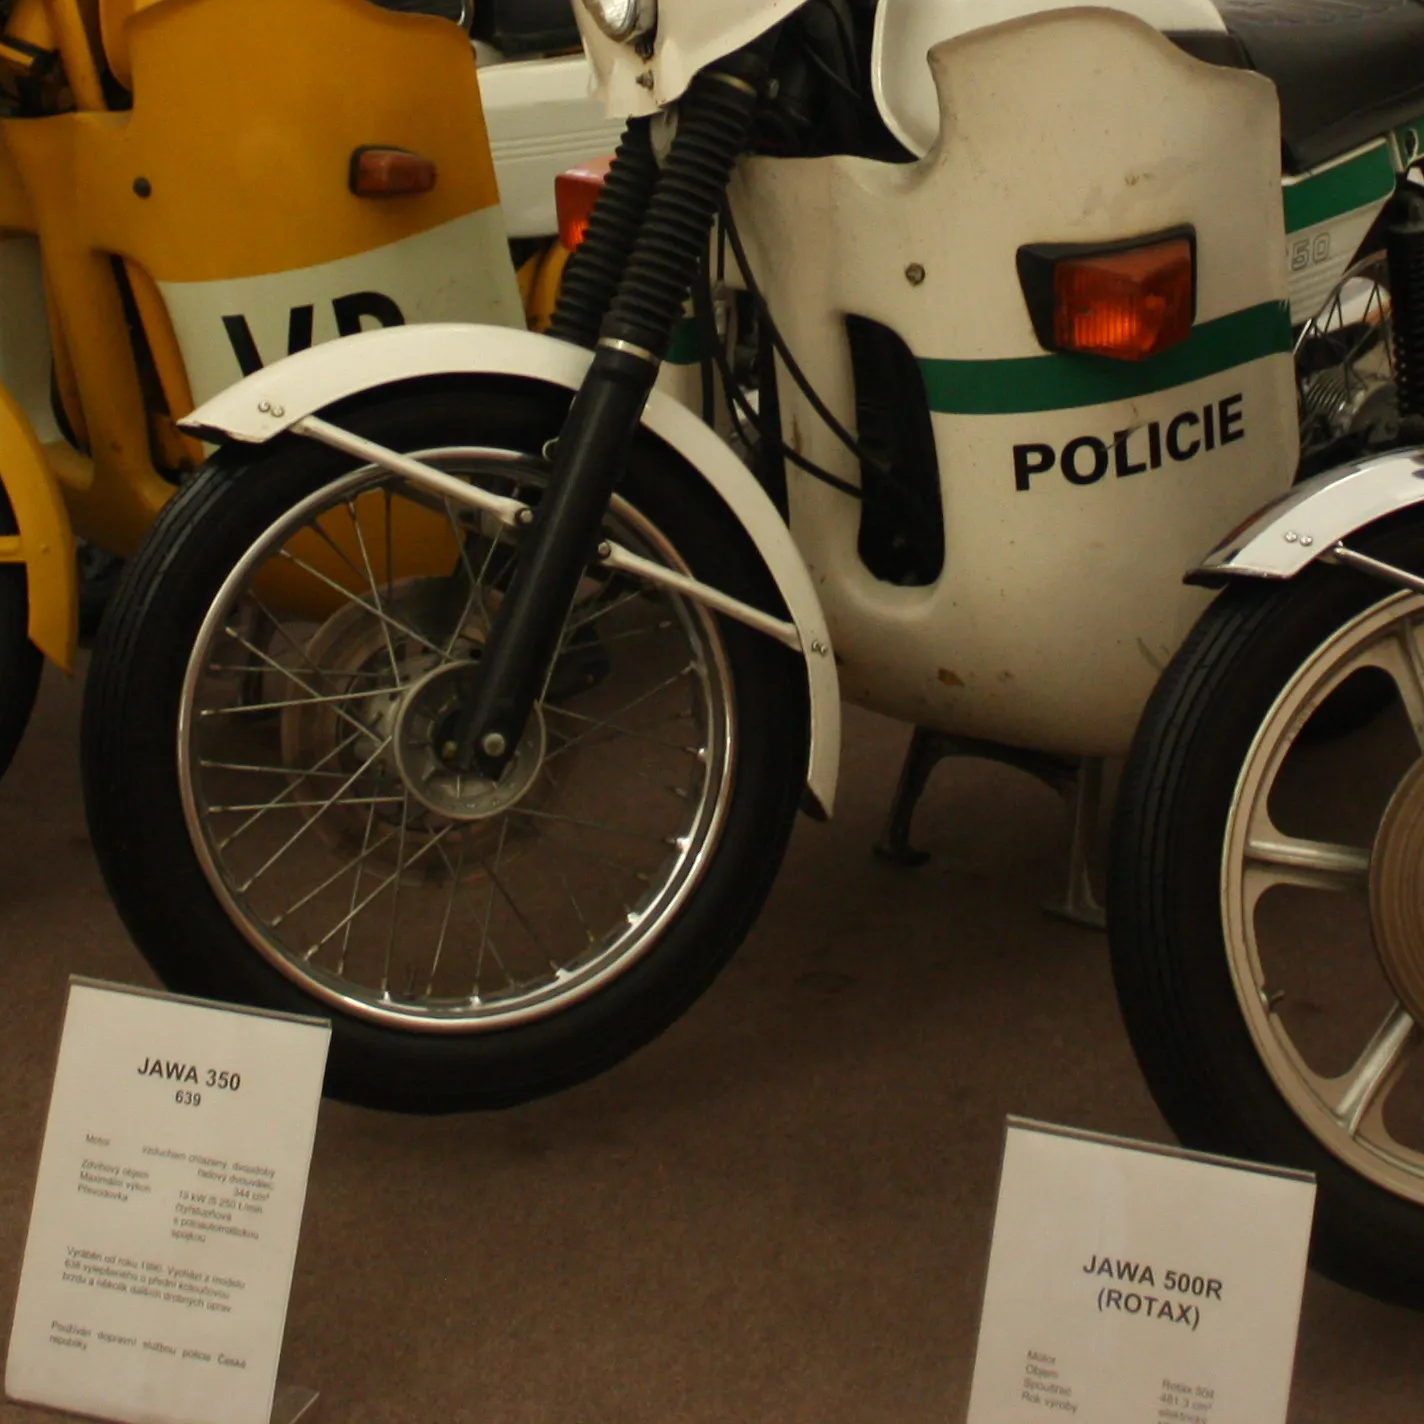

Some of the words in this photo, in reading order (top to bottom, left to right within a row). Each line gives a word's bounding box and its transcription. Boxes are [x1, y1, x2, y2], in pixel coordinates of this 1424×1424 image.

[1286, 232, 1330, 271] 50
[1013, 393, 1244, 491] POLICIE
[137, 1058, 198, 1084] JAWA
[206, 1069, 240, 1091] 350
[175, 1090, 201, 1106] 639
[1083, 1255, 1155, 1287] JAWA
[1164, 1271, 1222, 1301] 500R
[1098, 1287, 1200, 1331] (ROTAX)
